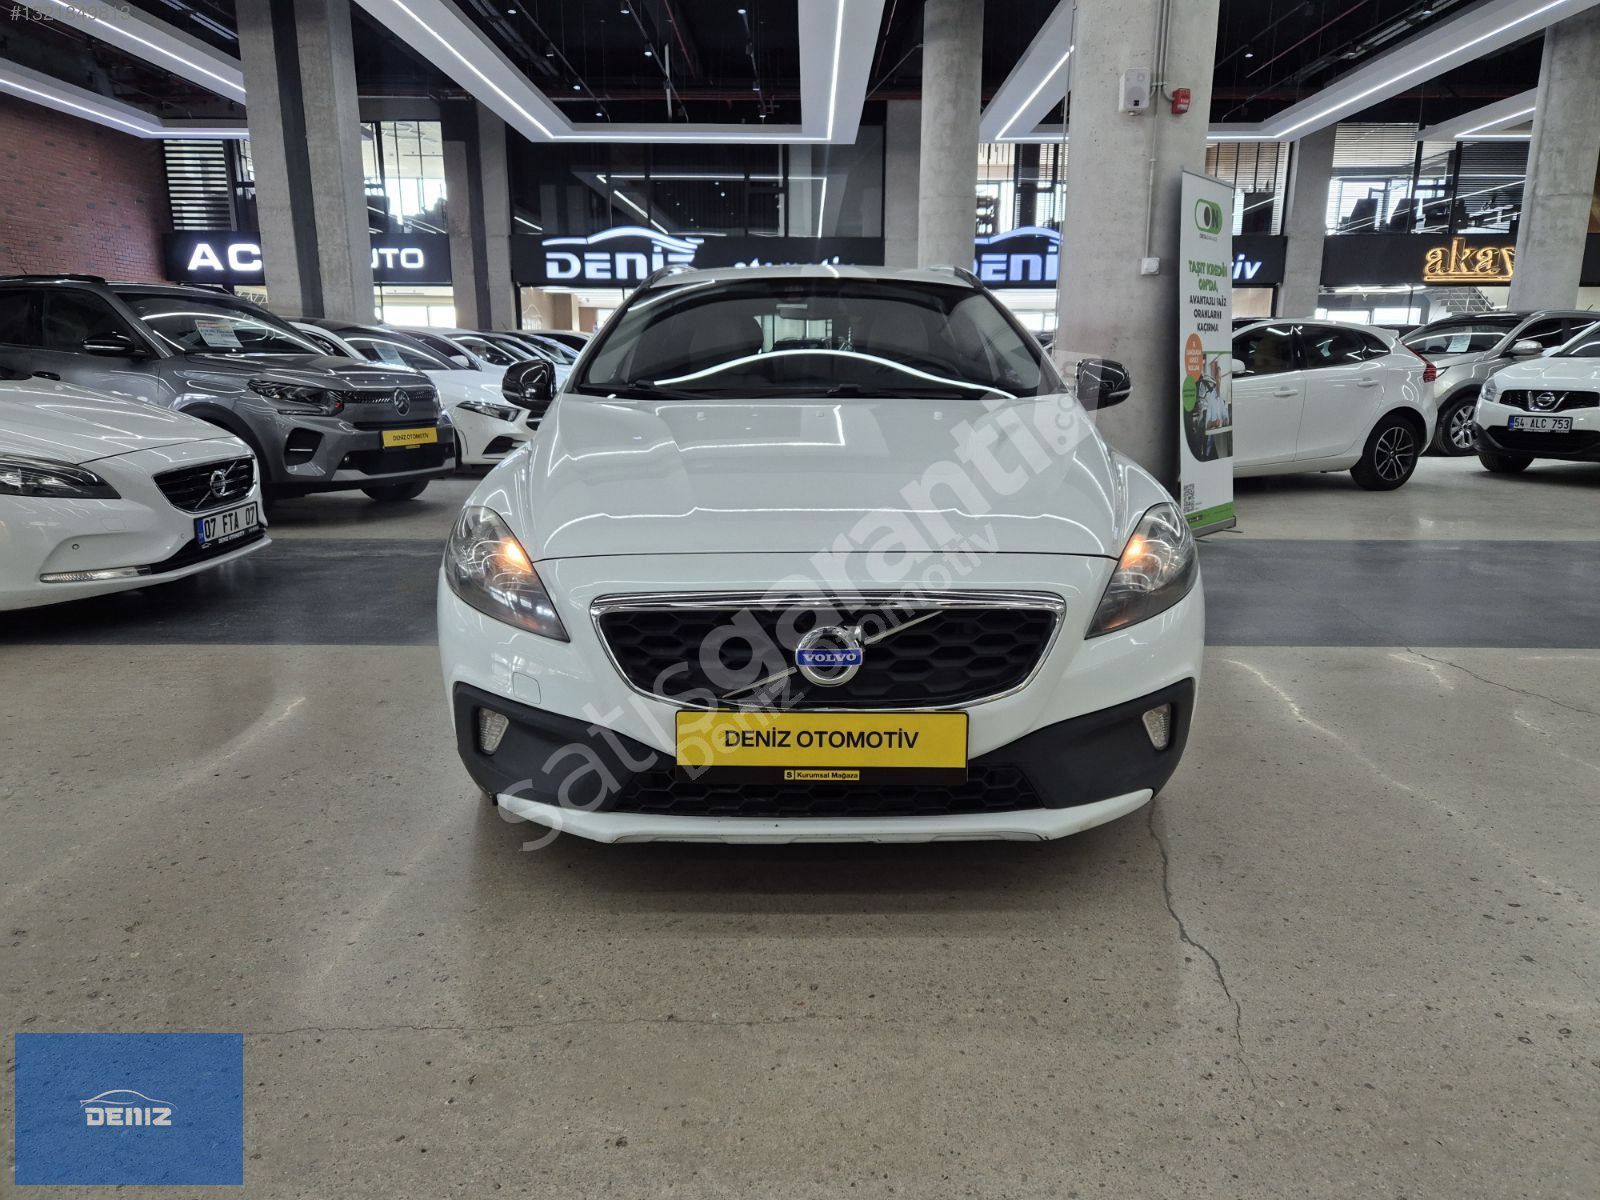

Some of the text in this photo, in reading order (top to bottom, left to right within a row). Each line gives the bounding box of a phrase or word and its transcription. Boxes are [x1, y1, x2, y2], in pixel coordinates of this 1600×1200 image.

[1514, 417, 1570, 430] 54 ALC 753
[204, 506, 255, 538] 07 FTA 07
[803, 653, 857, 662] VOLVO
[725, 727, 920, 749] DENİZ OTOMOTİV
[796, 771, 830, 779] Kurumsal
[831, 770, 858, 780] Mağaza
